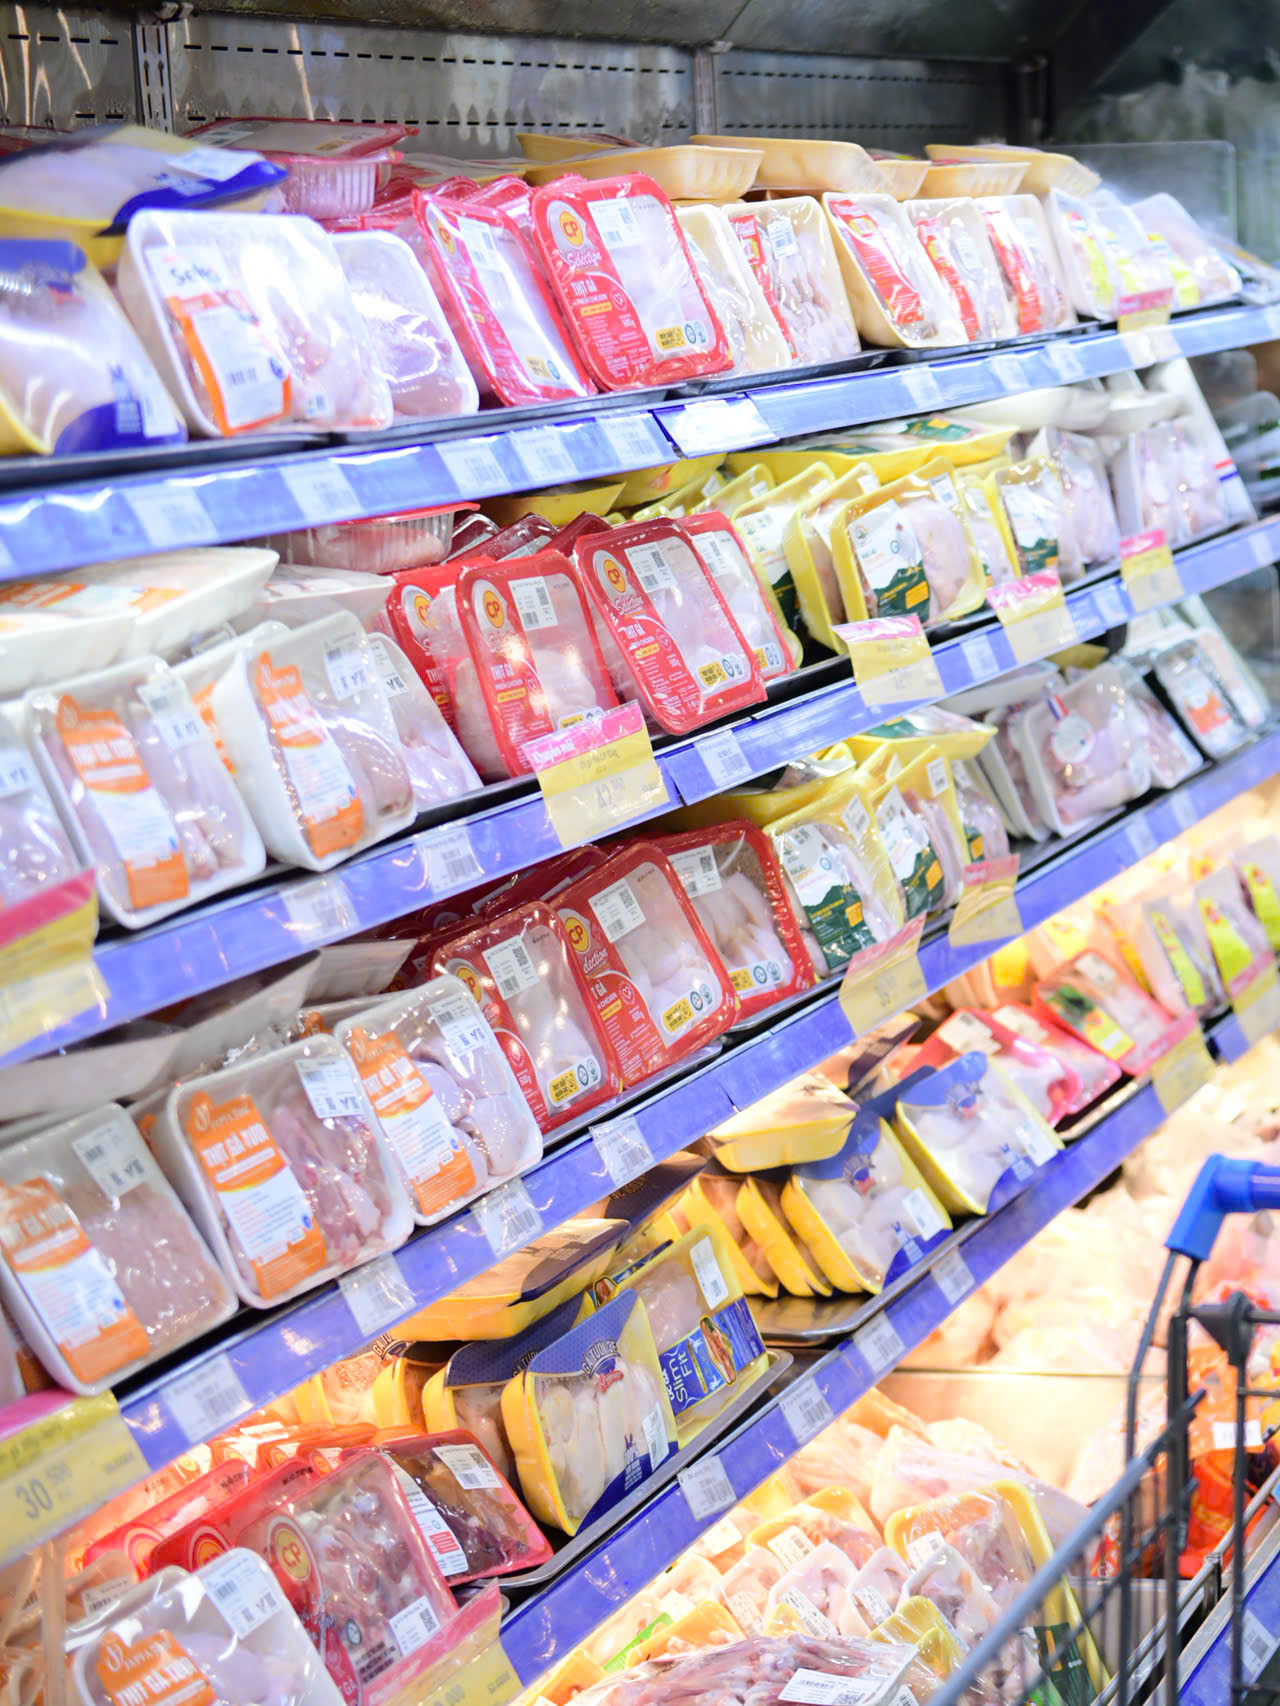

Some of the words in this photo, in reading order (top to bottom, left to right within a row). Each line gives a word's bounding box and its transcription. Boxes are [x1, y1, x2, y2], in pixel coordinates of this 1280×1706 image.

[563, 221, 579, 238] CP
[607, 567, 621, 585] CP
[486, 601, 500, 618] CP
[568, 925, 584, 945] CP
[583, 948, 609, 972] election
[679, 1351, 693, 1378] Fit
[668, 1358, 688, 1402] Slim
[16, 1479, 54, 1520] 30
[281, 1541, 303, 1569] CP
